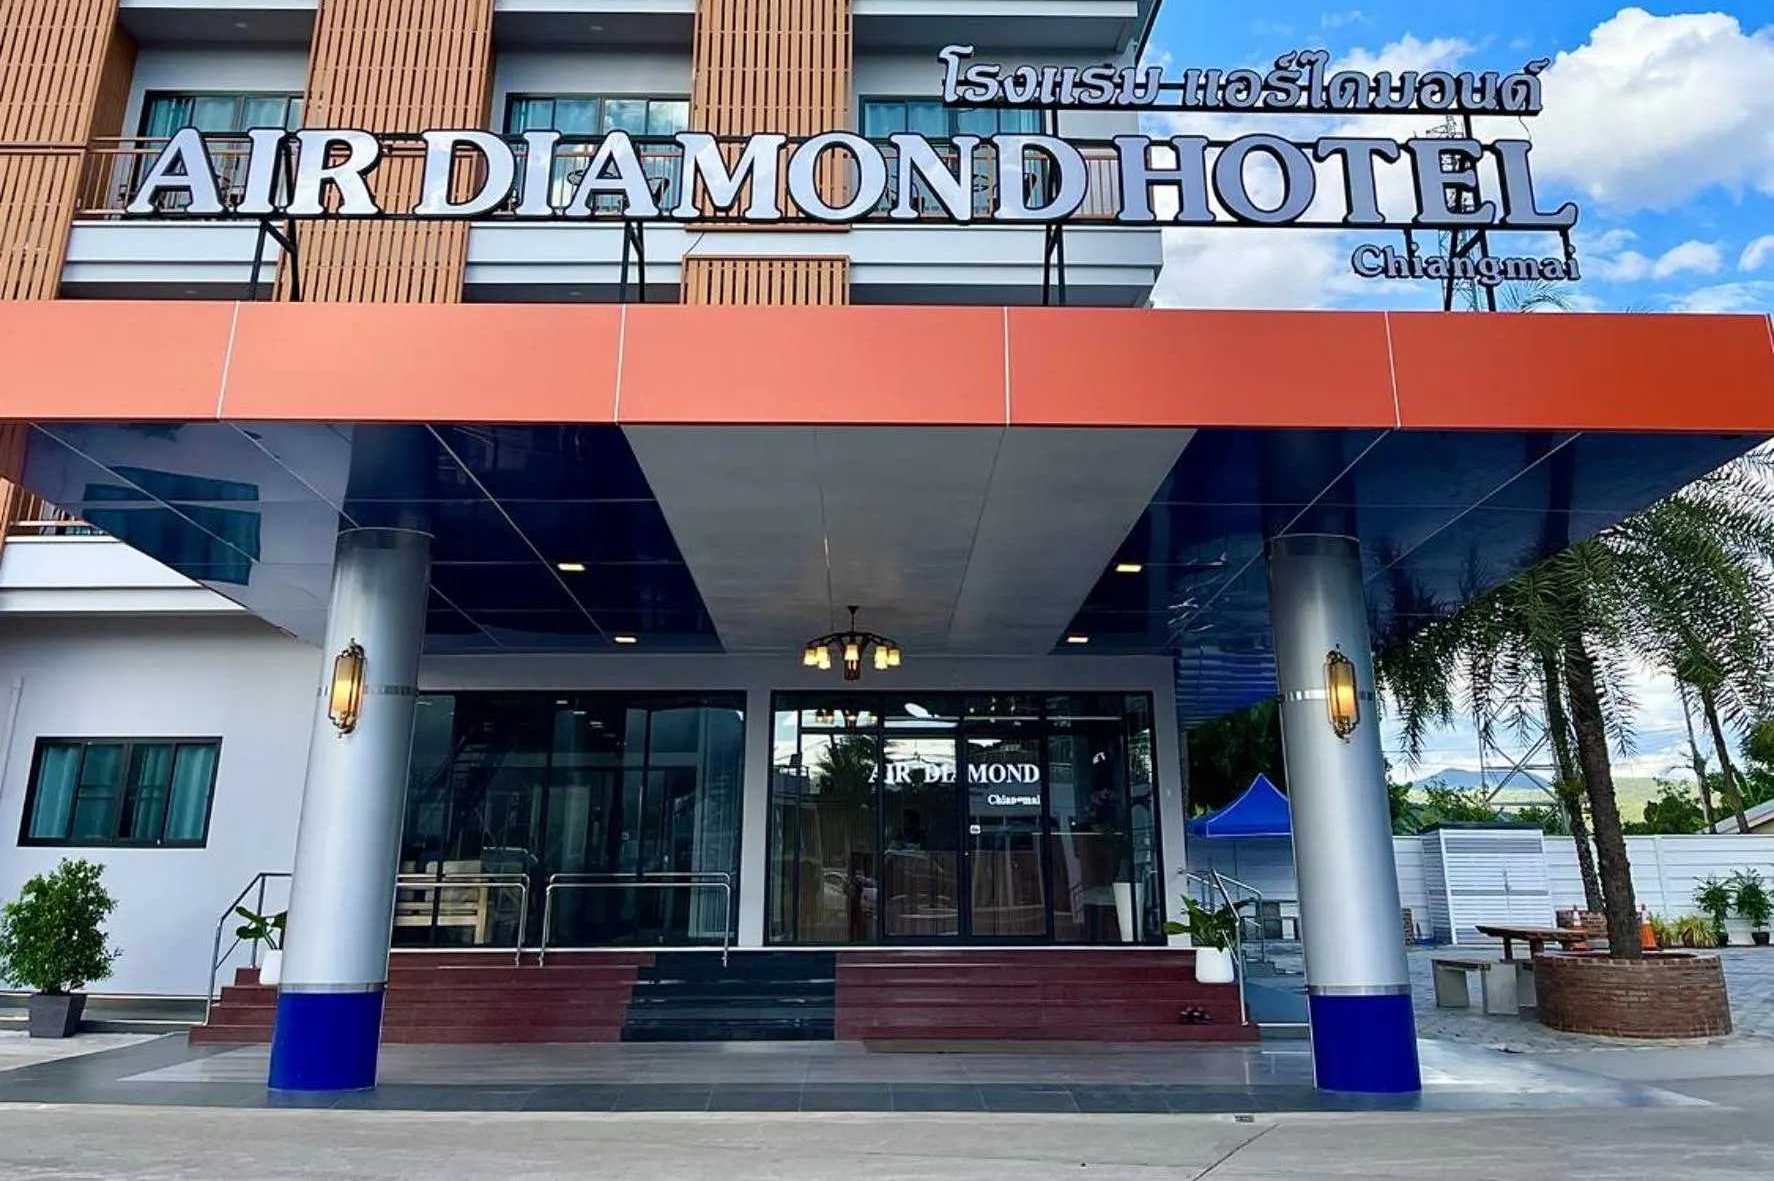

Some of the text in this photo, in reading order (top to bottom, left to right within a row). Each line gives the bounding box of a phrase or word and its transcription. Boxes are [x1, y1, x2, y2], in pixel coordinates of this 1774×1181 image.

[938, 43, 1551, 115] โรงแรม แอร์ไดมอนด์
[124, 126, 1580, 229] AIR DIAMOND HOTEL
[1351, 242, 1582, 286] Chiangmai
